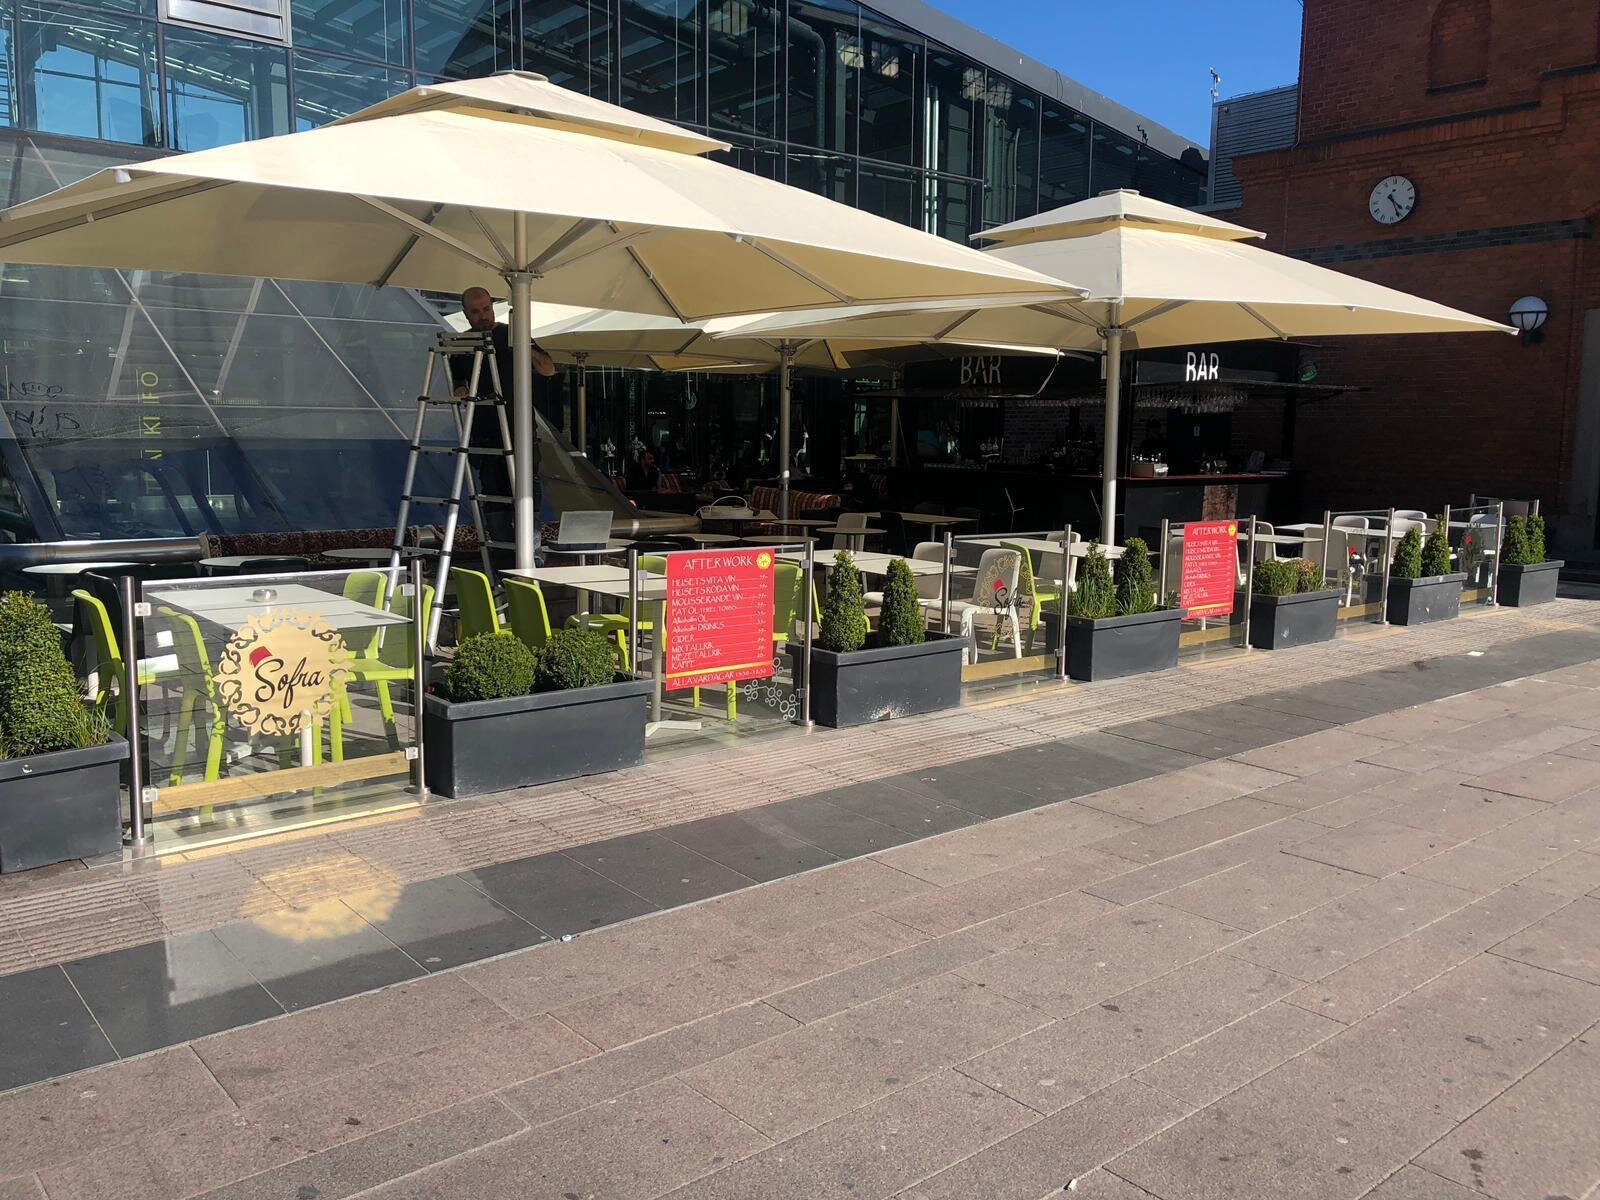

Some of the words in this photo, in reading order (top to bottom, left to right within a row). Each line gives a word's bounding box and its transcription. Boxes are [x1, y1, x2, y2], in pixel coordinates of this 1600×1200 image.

[961, 356, 1001, 384] BAR
[1186, 351, 1219, 382] BAR
[683, 557, 720, 570] AFTER
[723, 555, 754, 567] WORK
[254, 657, 324, 709] Sofra
